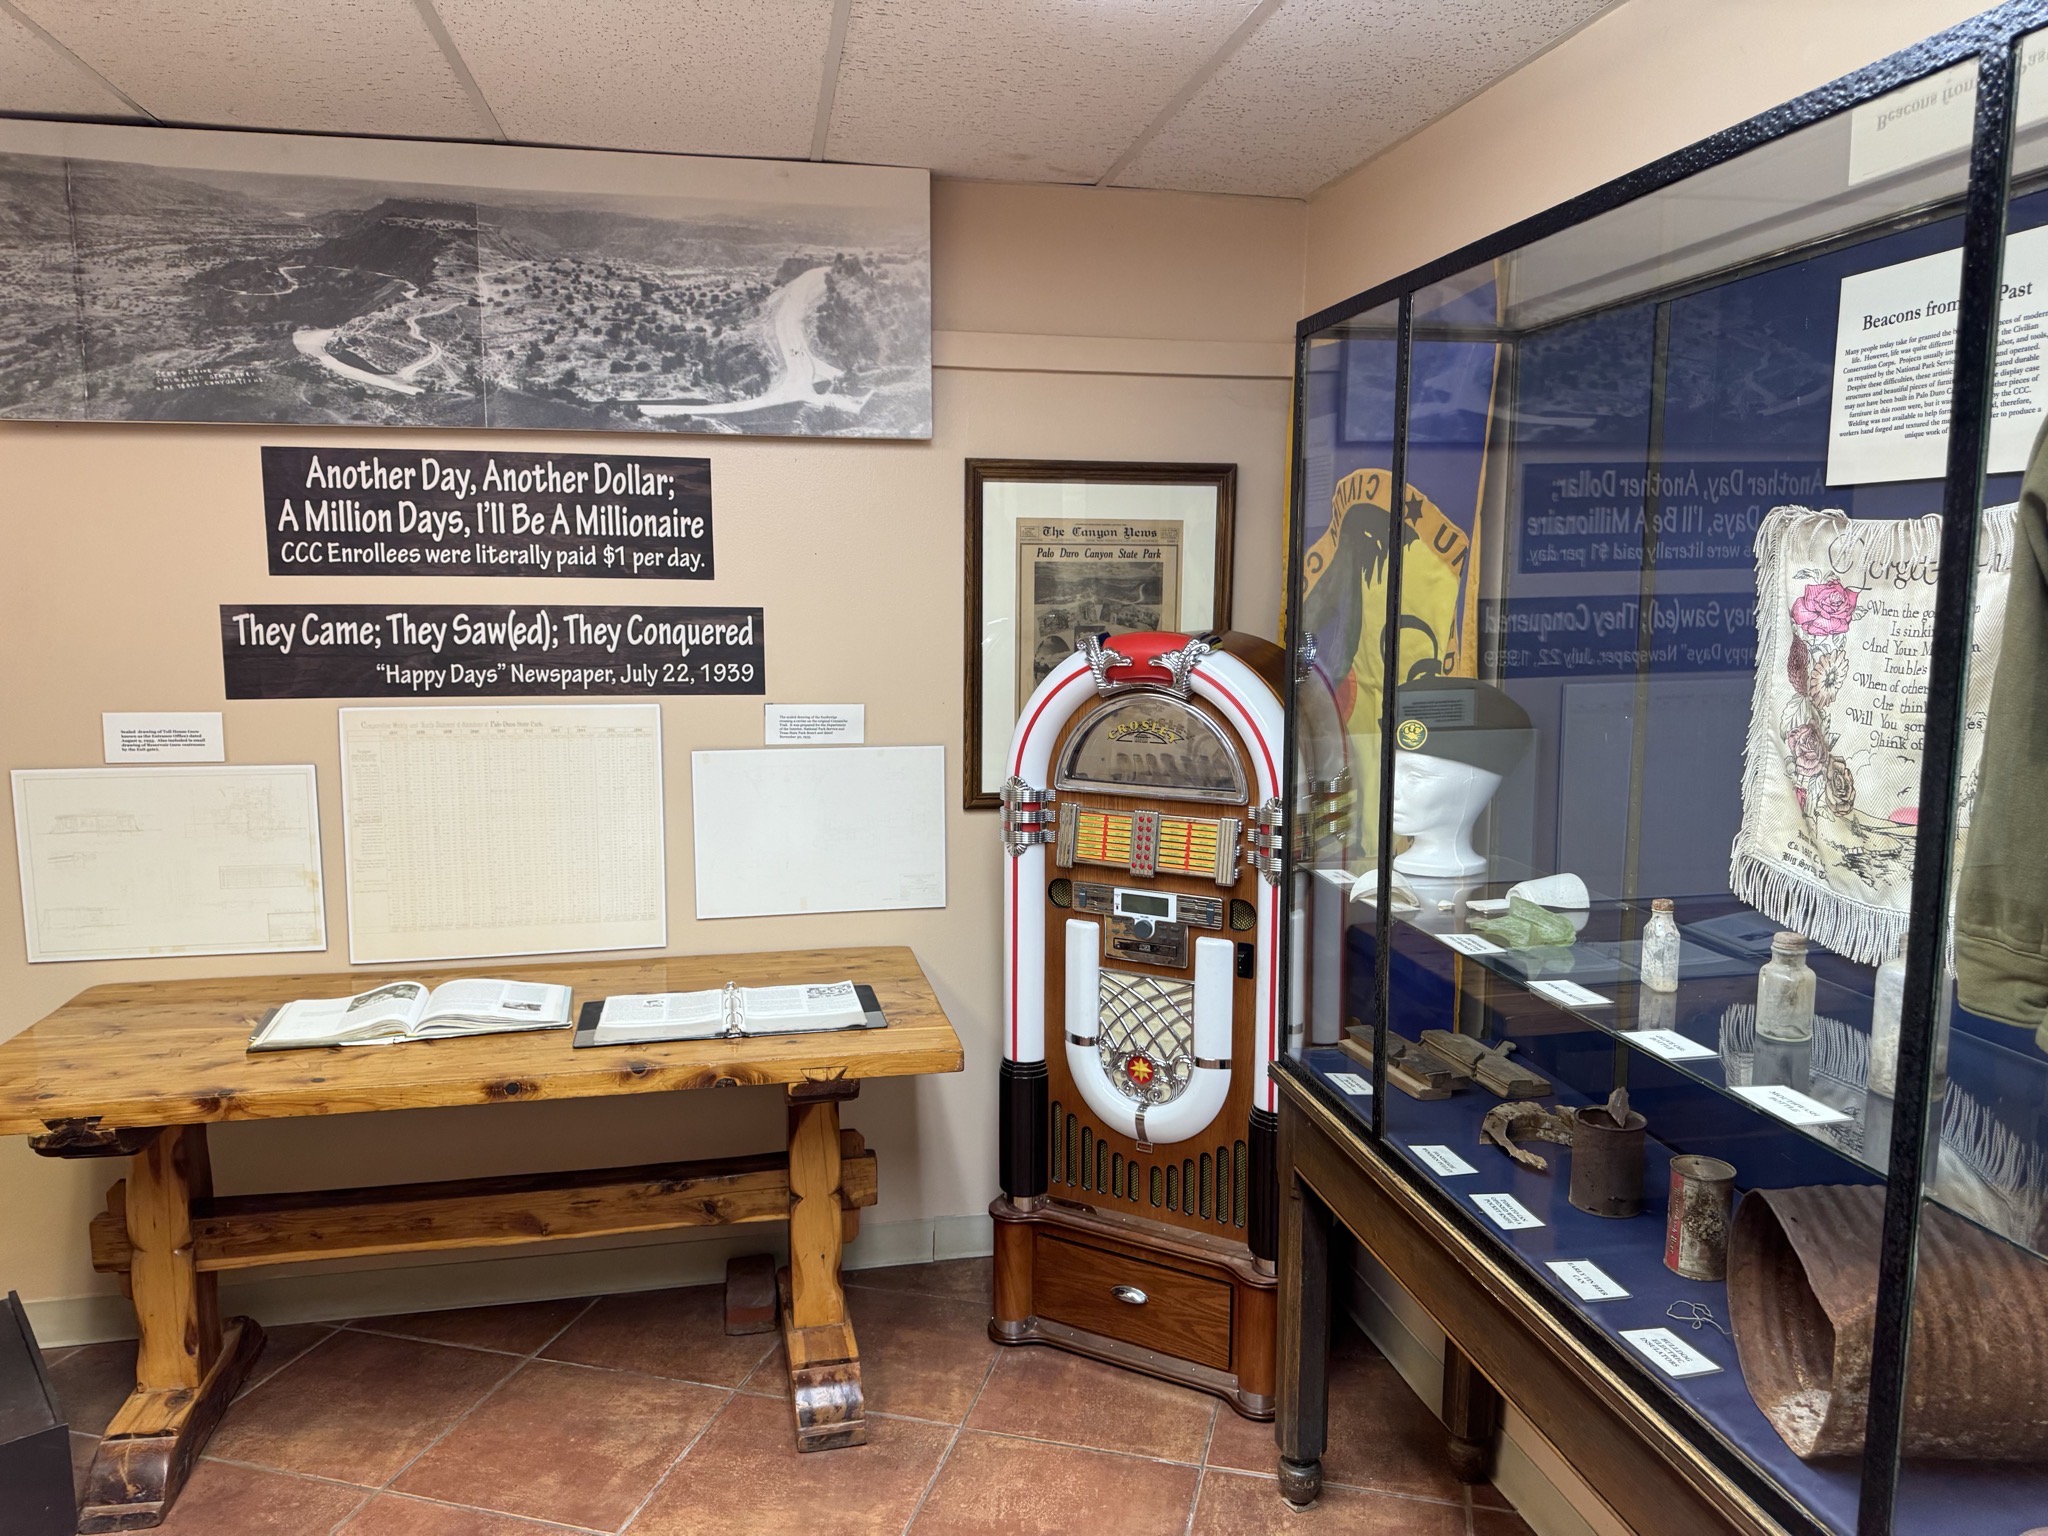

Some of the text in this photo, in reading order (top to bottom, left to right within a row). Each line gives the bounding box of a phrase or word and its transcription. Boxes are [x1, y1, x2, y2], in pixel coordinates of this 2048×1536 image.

[1862, 282, 2032, 330] Beacons from Past
[306, 455, 675, 500] Another Day, Another Dollar;
[277, 498, 704, 542] A Million Days, I'll Be A Millionaire
[1042, 526, 1158, 540] The Canyon News
[281, 541, 705, 574] CCC Enrollees were literally paid $1 per day.
[1036, 547, 1162, 560] Palo Duro Canyon State Park
[1867, 600, 1899, 617] When
[1902, 604, 1919, 619] the
[232, 609, 754, 657] They Came; They Saw(ed); They Conquered
[1890, 620, 1935, 637] Is sinki
[1862, 637, 1889, 654] And
[1893, 640, 1918, 657] Your
[510, 663, 616, 690] Newspaper,
[620, 663, 658, 687] July
[662, 663, 695, 685] 22,
[700, 663, 754, 683] 1939
[1852, 672, 1887, 691] When
[1889, 679, 1901, 693] of
[1873, 695, 1894, 711] Are
[1845, 707, 1873, 726] Will
[1881, 712, 1897, 730] You
[1108, 720, 1176, 743] CROSLEY
[1869, 730, 1907, 749] Think
[1567, 1262, 1608, 1296] EARLY TIN BEER
[1573, 1274, 1586, 1284] CAN
[1639, 1337, 1679, 1367] INSULATORS
[1651, 1338, 1684, 1363] ELECTRIC
[1660, 1338, 1692, 1361] BULLDOG
